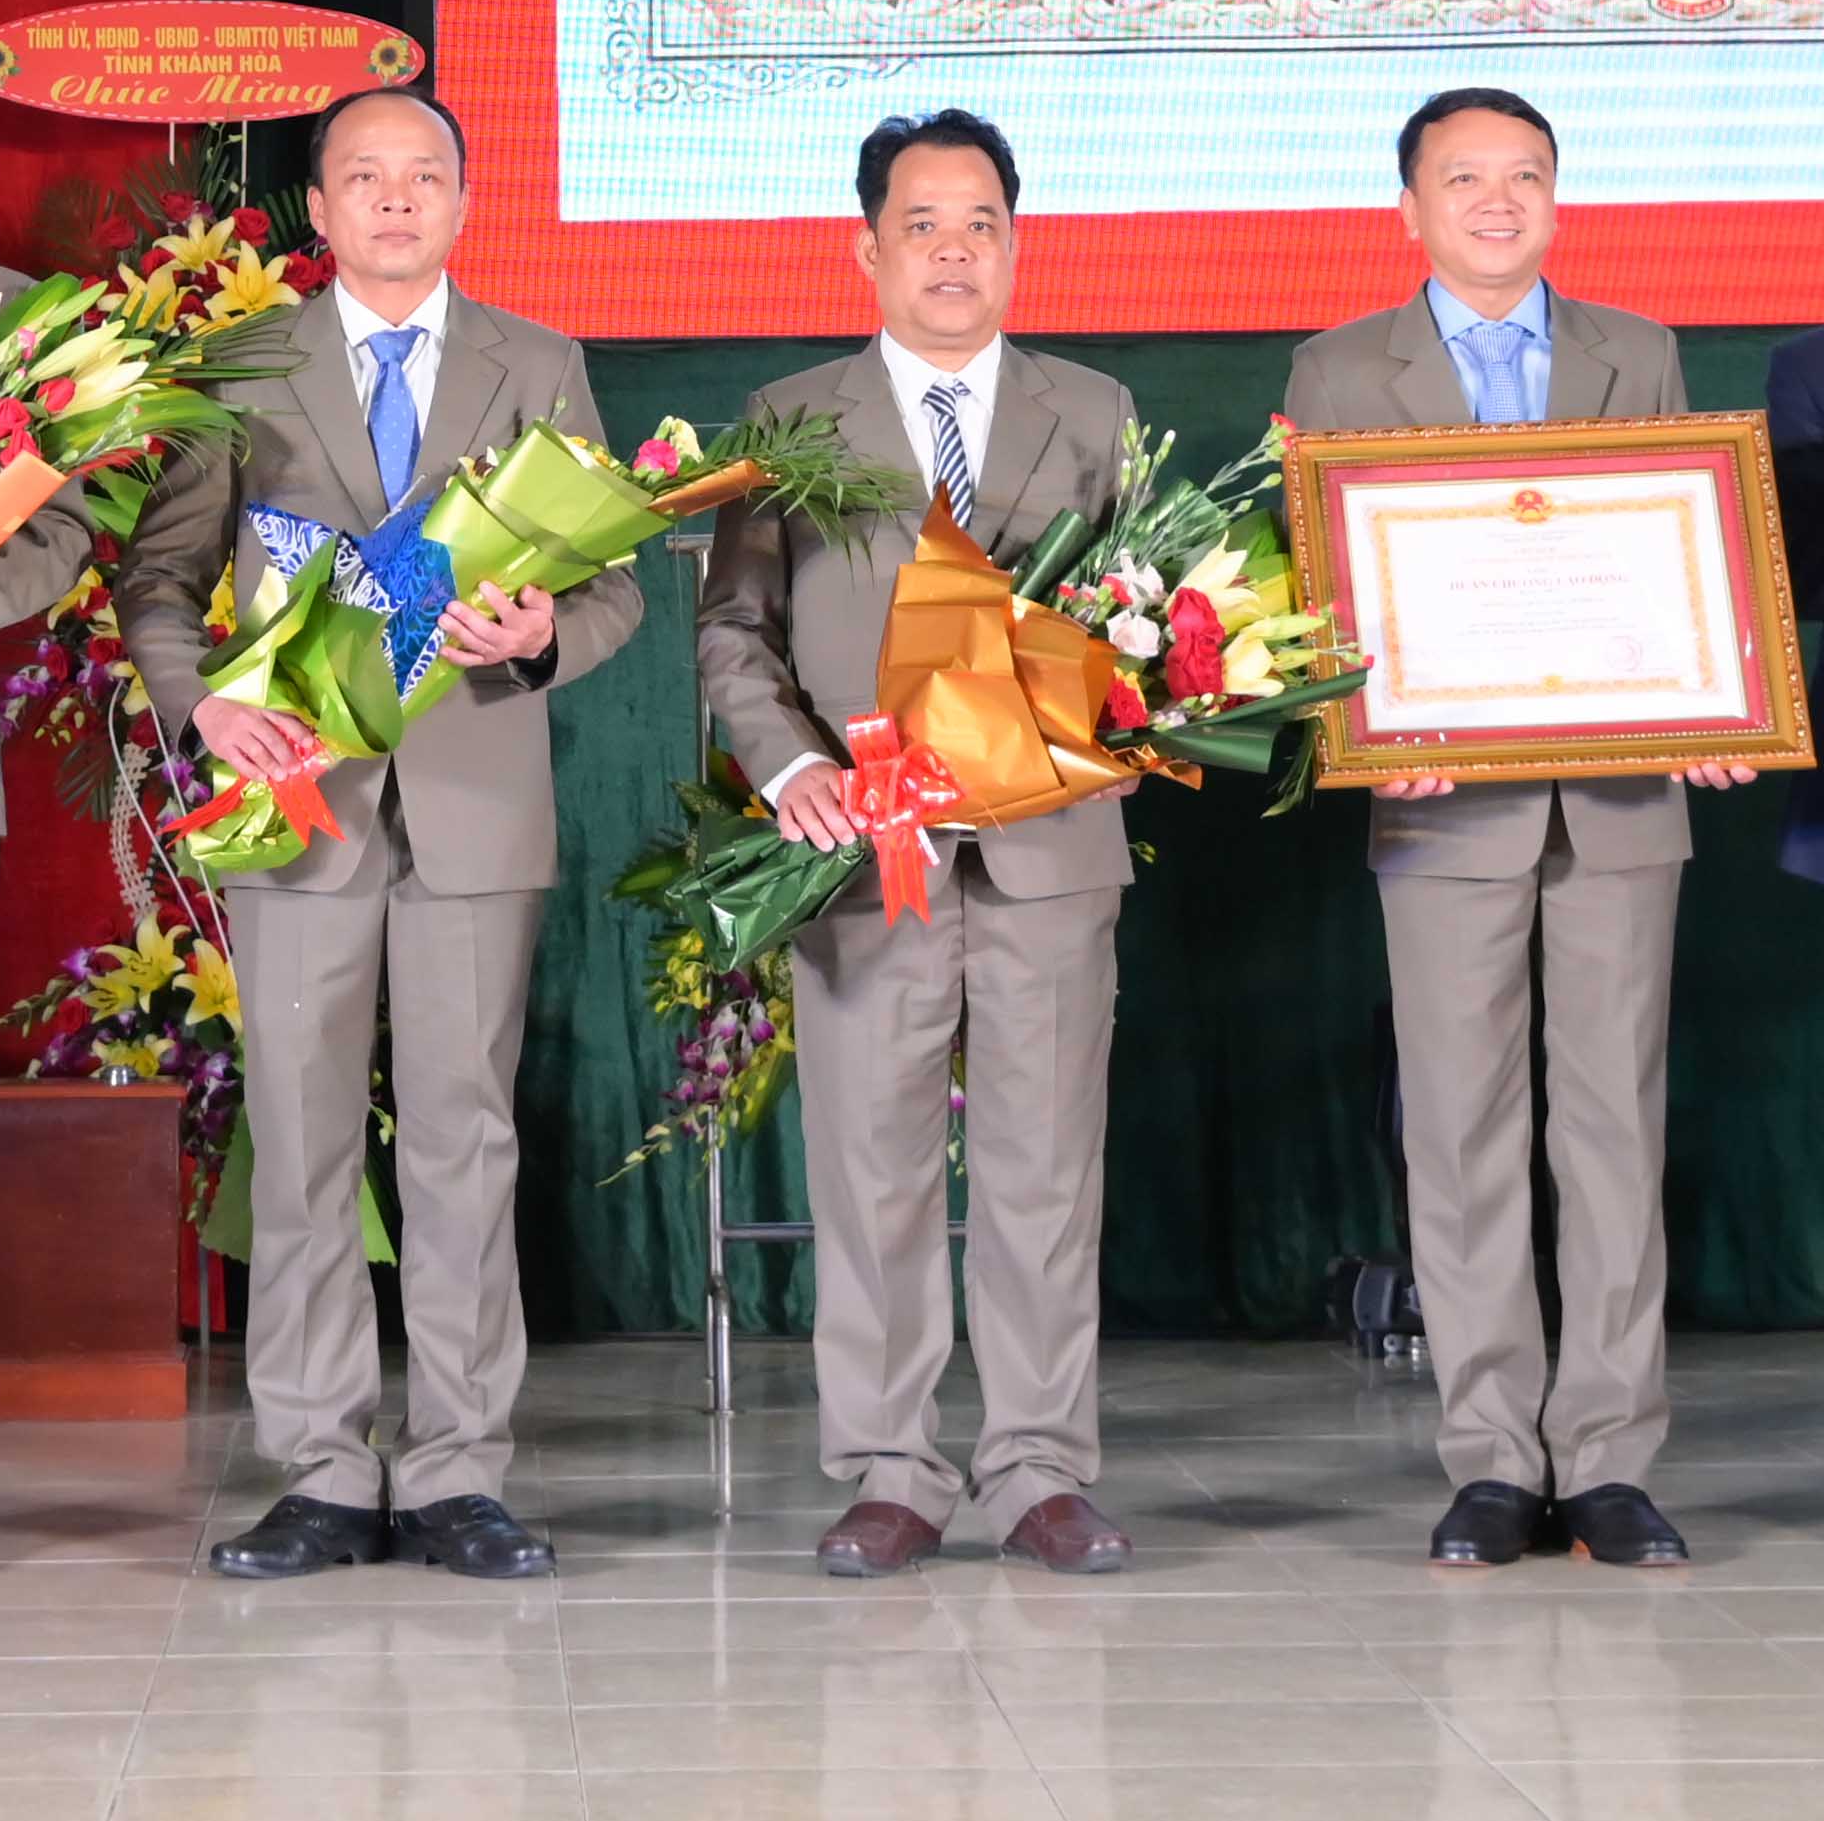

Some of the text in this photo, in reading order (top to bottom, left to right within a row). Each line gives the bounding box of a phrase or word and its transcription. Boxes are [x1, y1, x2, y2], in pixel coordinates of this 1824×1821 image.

[26, 21, 64, 49] TỈNH
[67, 20, 91, 52] ỦY,
[95, 26, 140, 50] HĐND
[155, 26, 200, 50] UBND
[215, 26, 279, 51] UBMTTQ
[283, 22, 317, 52] VIỆT
[321, 26, 358, 48] NAM
[104, 48, 284, 75] TỈNH KHÁNH HÒA
[50, 73, 333, 111] Chúc Mừng
